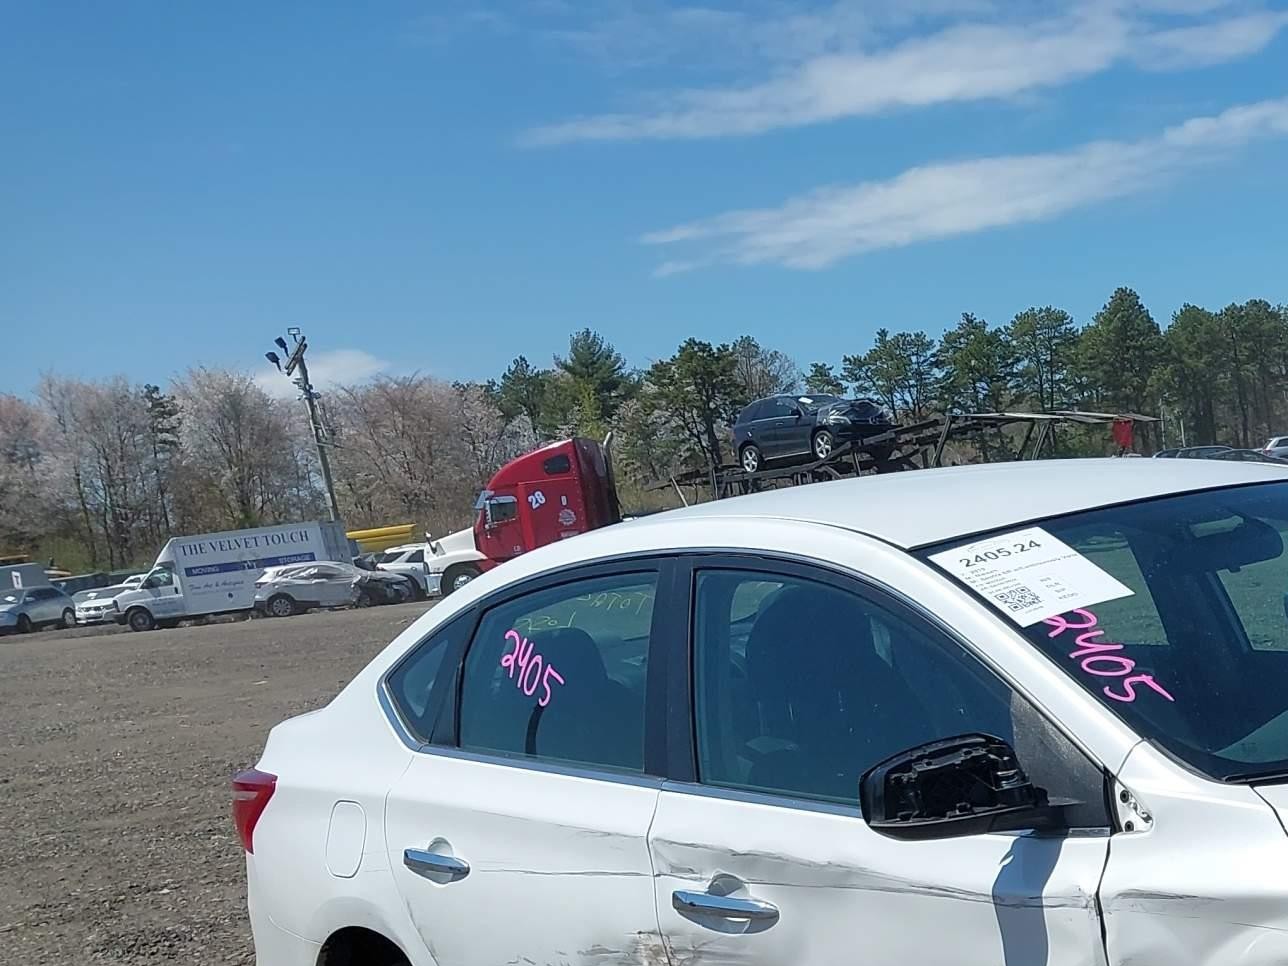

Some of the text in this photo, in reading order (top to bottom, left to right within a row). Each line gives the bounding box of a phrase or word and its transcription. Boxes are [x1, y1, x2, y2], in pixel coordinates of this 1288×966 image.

[527, 490, 546, 510] 28
[179, 529, 309, 556] THE VELVET TOUCH
[958, 539, 1042, 568] 2405.24
[501, 629, 565, 708] 2405
[1042, 608, 1176, 703] 2405
